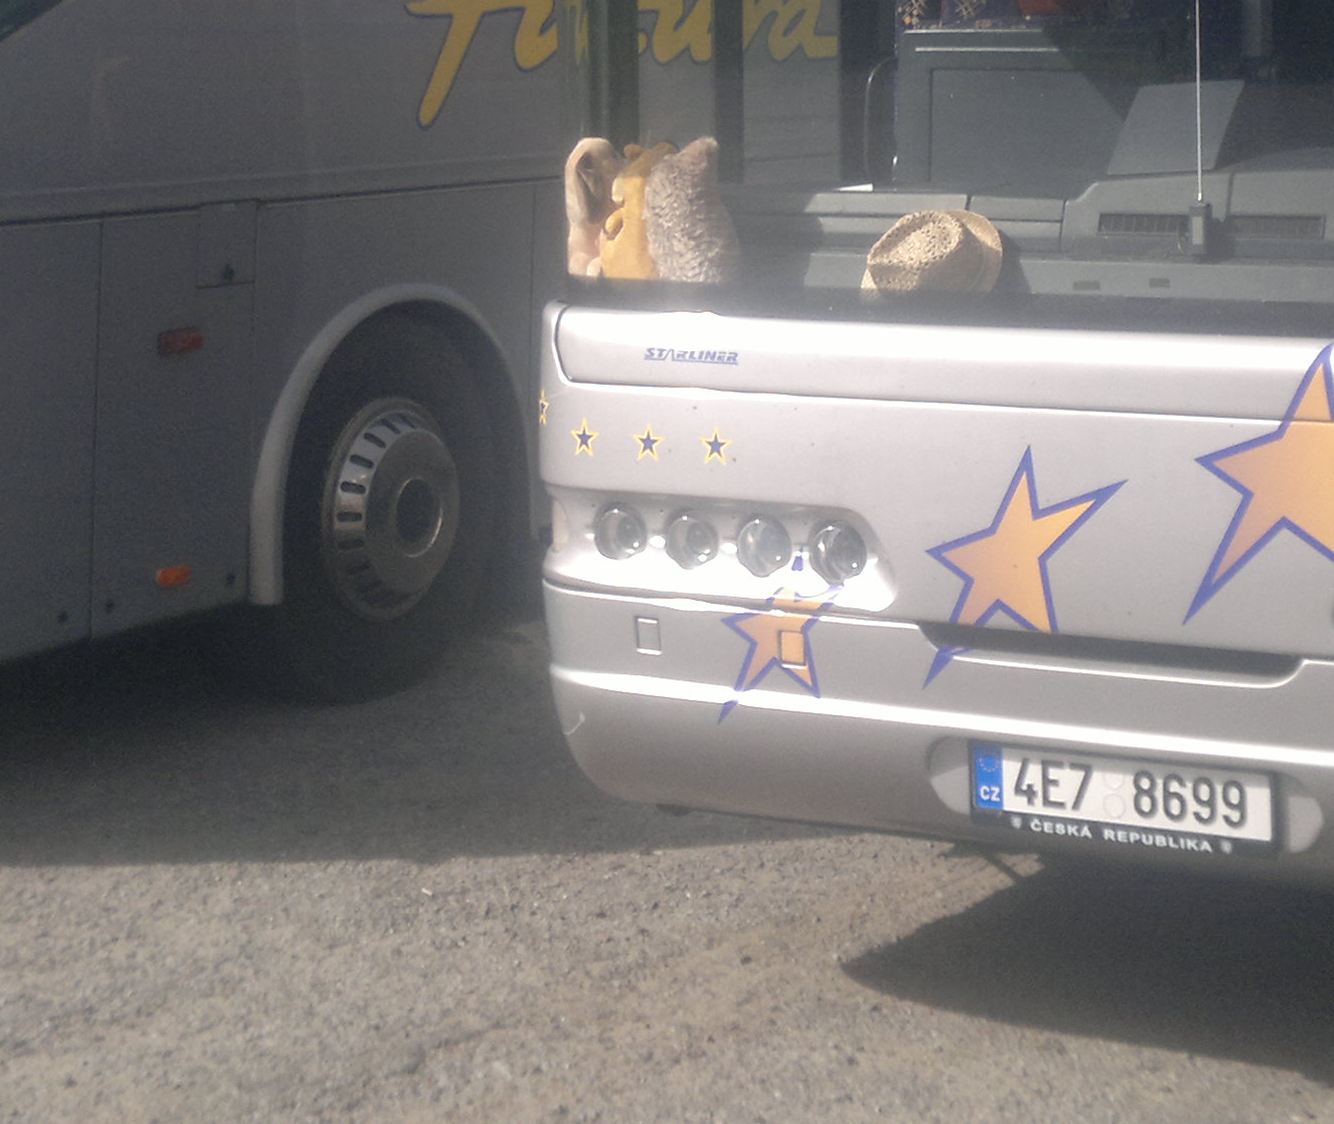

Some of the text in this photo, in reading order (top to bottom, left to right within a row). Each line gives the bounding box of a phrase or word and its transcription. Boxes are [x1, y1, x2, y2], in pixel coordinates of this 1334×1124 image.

[644, 347, 738, 365] STARLINER
[980, 757, 1247, 827] CZ 4E7 8699
[1104, 830, 1213, 853] REPUBLIKA
